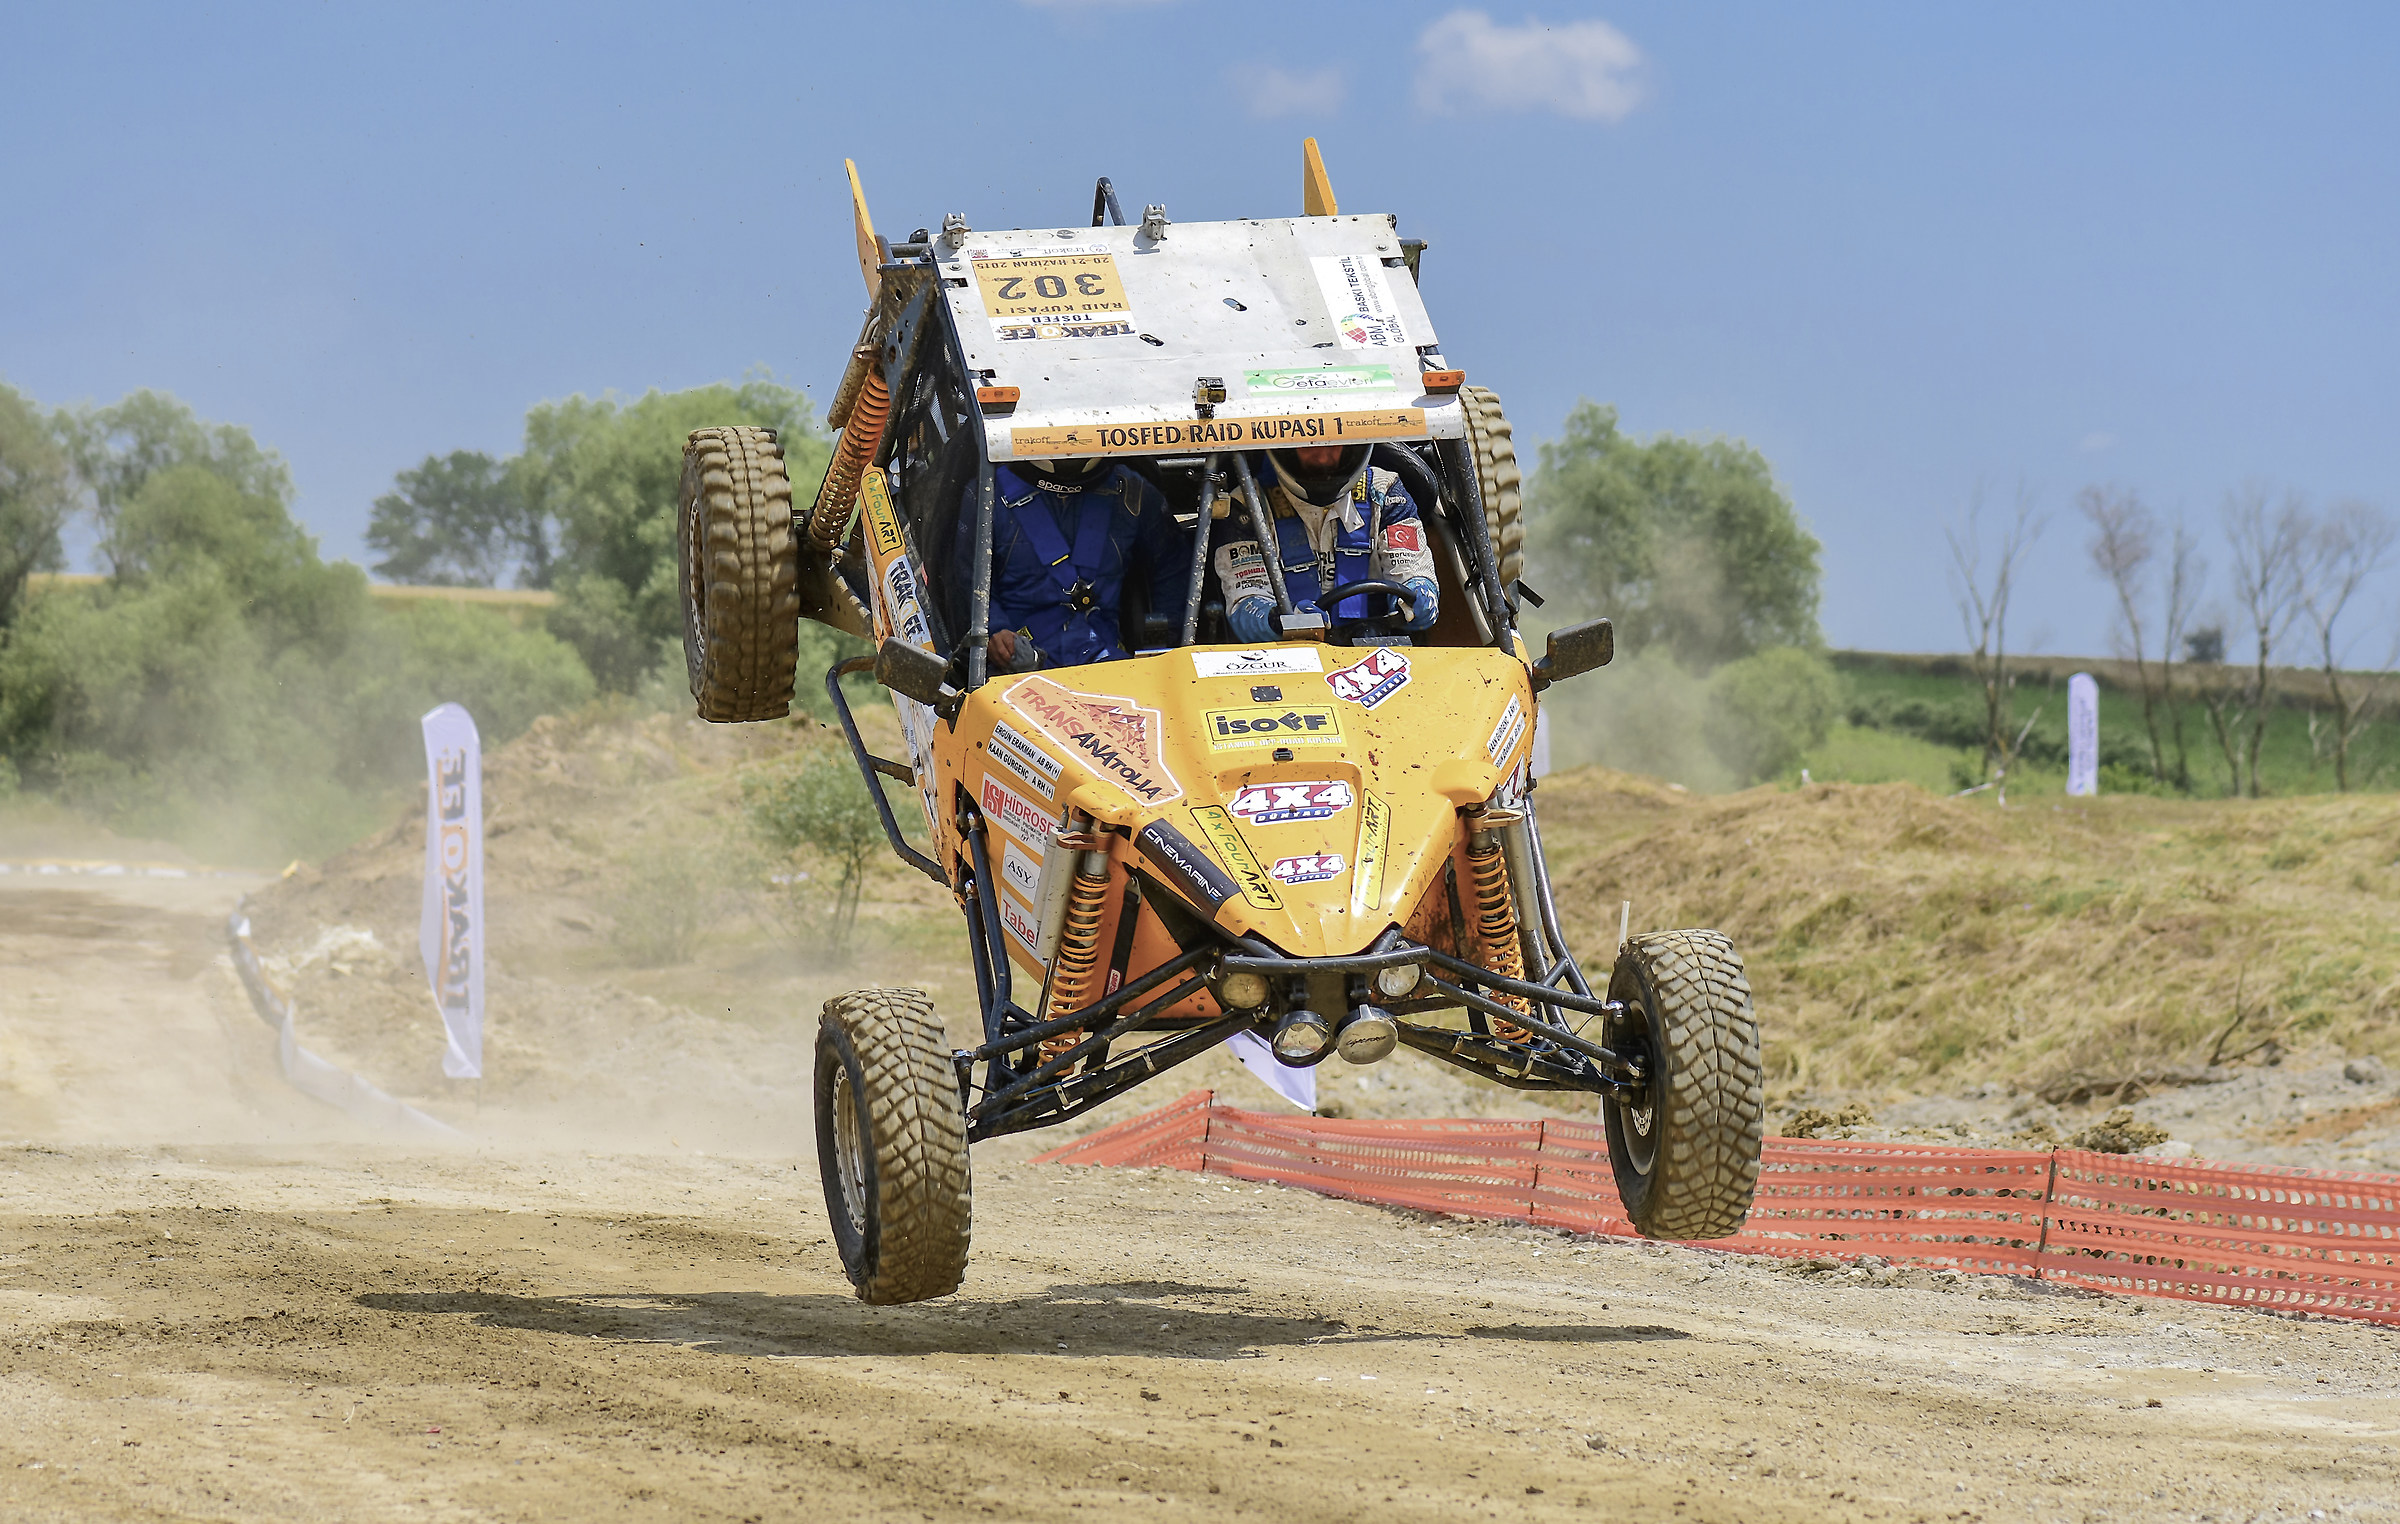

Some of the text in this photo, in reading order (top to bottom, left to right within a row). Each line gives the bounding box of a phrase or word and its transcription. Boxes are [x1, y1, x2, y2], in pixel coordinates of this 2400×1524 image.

[976, 261, 1007, 270] 2015
[993, 273, 1106, 300] 302
[1010, 303, 1075, 314] KUPASI
[1083, 302, 1123, 312] RAID
[1351, 288, 1370, 313] BASKI
[1031, 313, 1092, 324] TOSFED
[1366, 325, 1389, 347] ABM
[1096, 416, 1343, 447] TOSFED RAID KUPASI 1
[1346, 418, 1382, 427] trakoff
[1014, 436, 1051, 445] trakoff
[1037, 479, 1082, 493] sparco
[1235, 567, 1266, 579] TOSHIBA
[1011, 736, 1036, 759] ERAKMAN
[1037, 756, 1046, 766] AB
[1044, 761, 1054, 772] RH
[988, 741, 1004, 760] KAAN
[1003, 753, 1029, 781] GÜRGENÇ
[1037, 779, 1046, 792] RH
[1231, 783, 1352, 812] 4X4
[1008, 860, 1032, 885] ASY
[1144, 827, 1223, 901] CINEMARINE
[1271, 855, 1344, 877] 4X4
